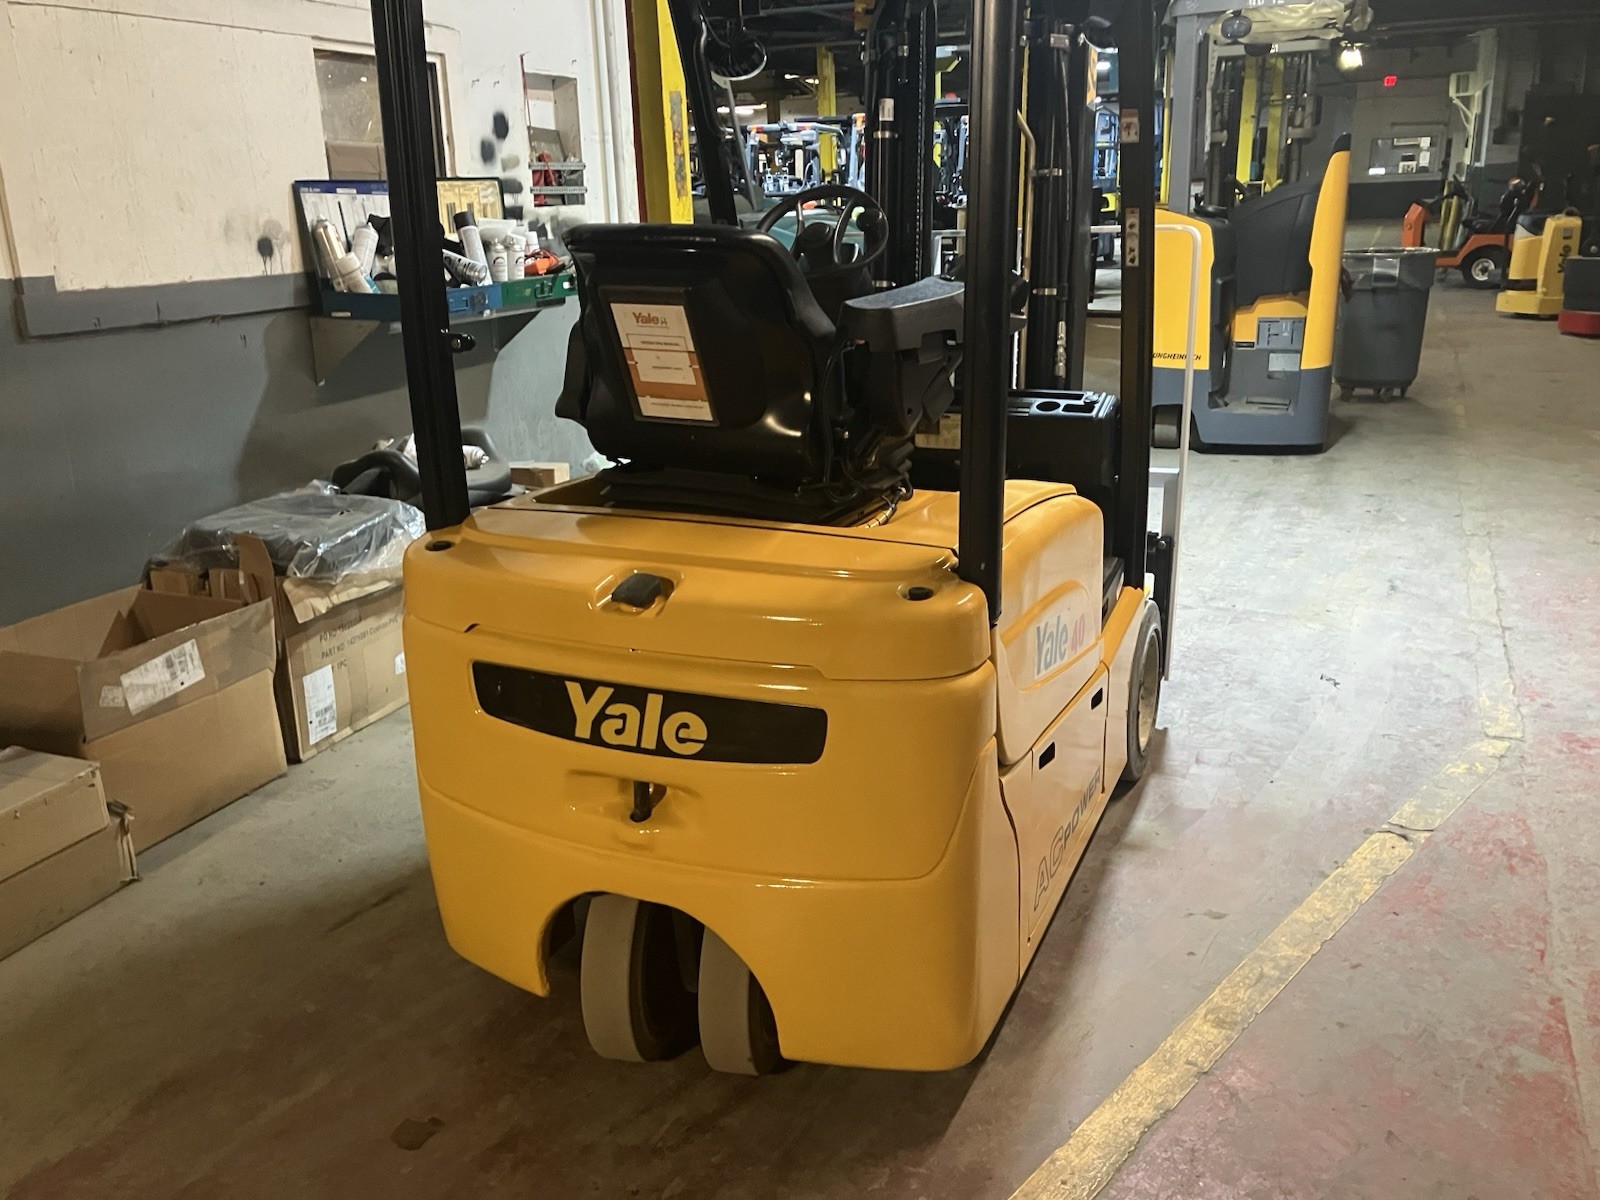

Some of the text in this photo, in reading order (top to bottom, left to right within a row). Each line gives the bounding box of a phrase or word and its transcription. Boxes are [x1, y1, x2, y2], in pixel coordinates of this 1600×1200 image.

[632, 312, 660, 325] Yale
[1153, 352, 1201, 360] UNGHEINH
[1036, 613, 1086, 676] Yale 40
[321, 645, 336, 659] PART
[564, 680, 708, 756] Yale
